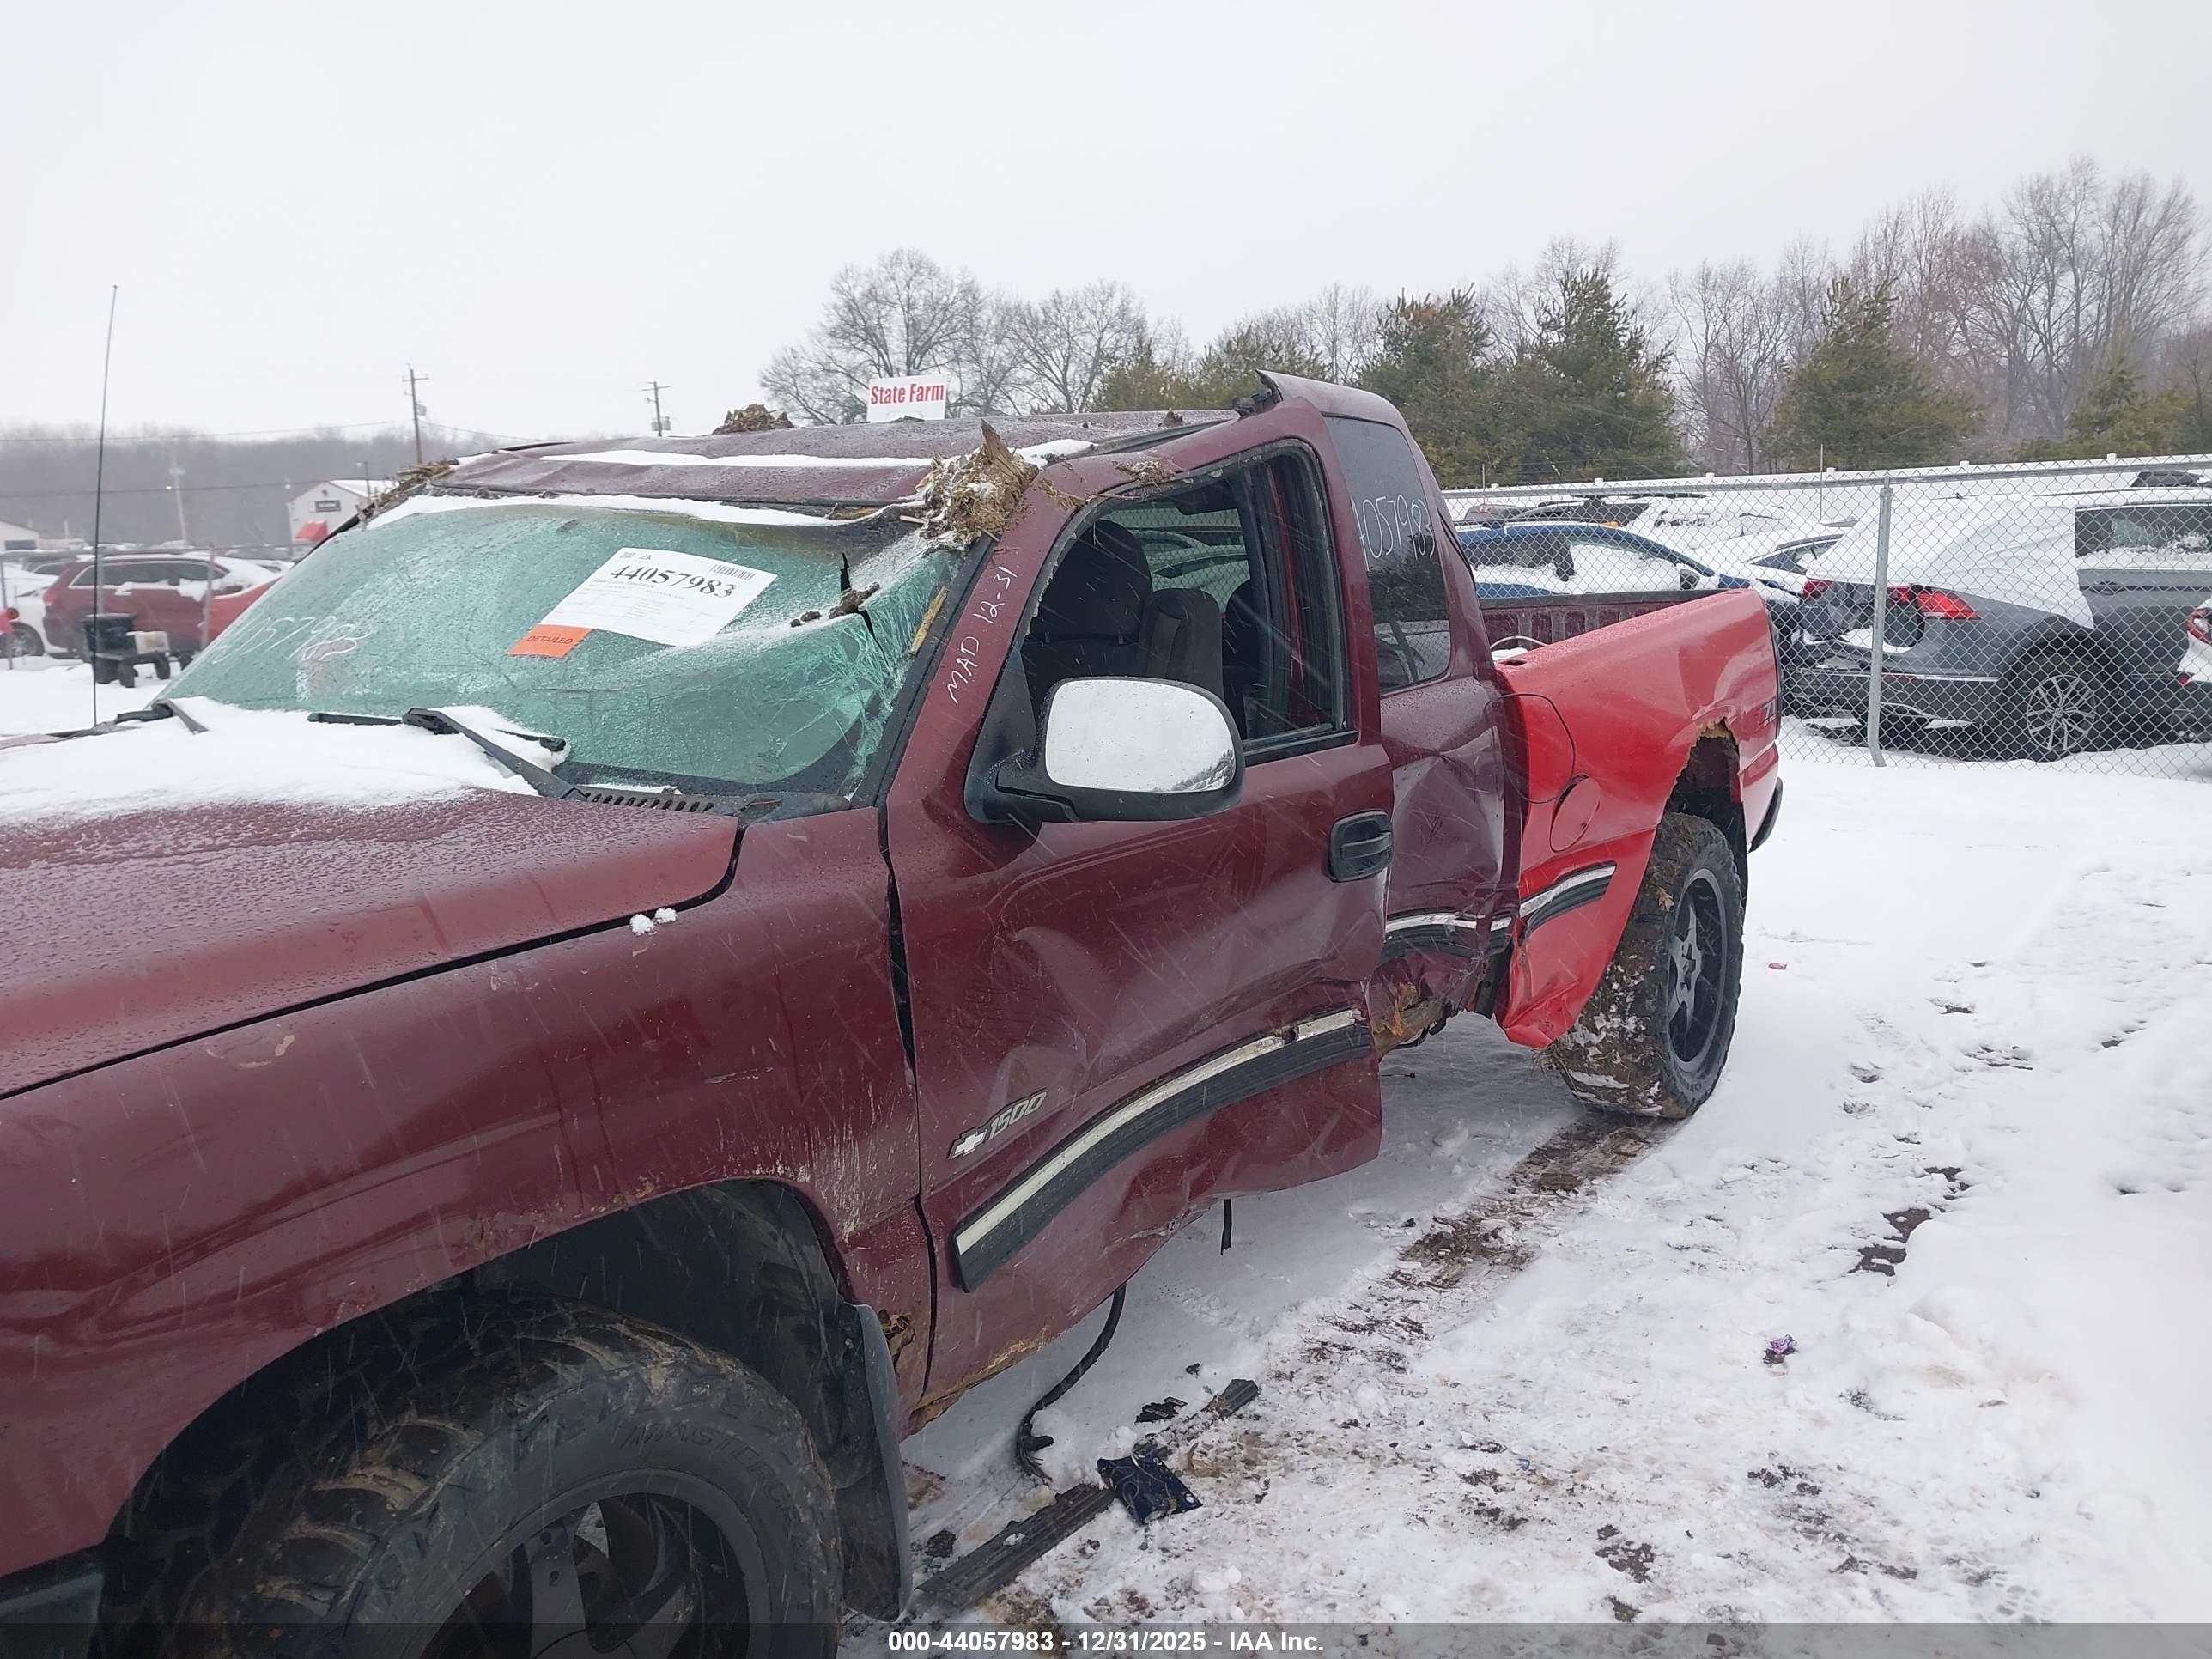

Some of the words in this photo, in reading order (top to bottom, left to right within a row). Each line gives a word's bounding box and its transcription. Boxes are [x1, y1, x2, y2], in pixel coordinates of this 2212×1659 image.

[871, 385, 906, 405] State
[909, 383, 945, 403] Farm
[611, 564, 736, 599] 44057983
[947, 635, 980, 705] MAD
[971, 565, 1018, 625] 12-31
[988, 1091, 1048, 1140] 1500
